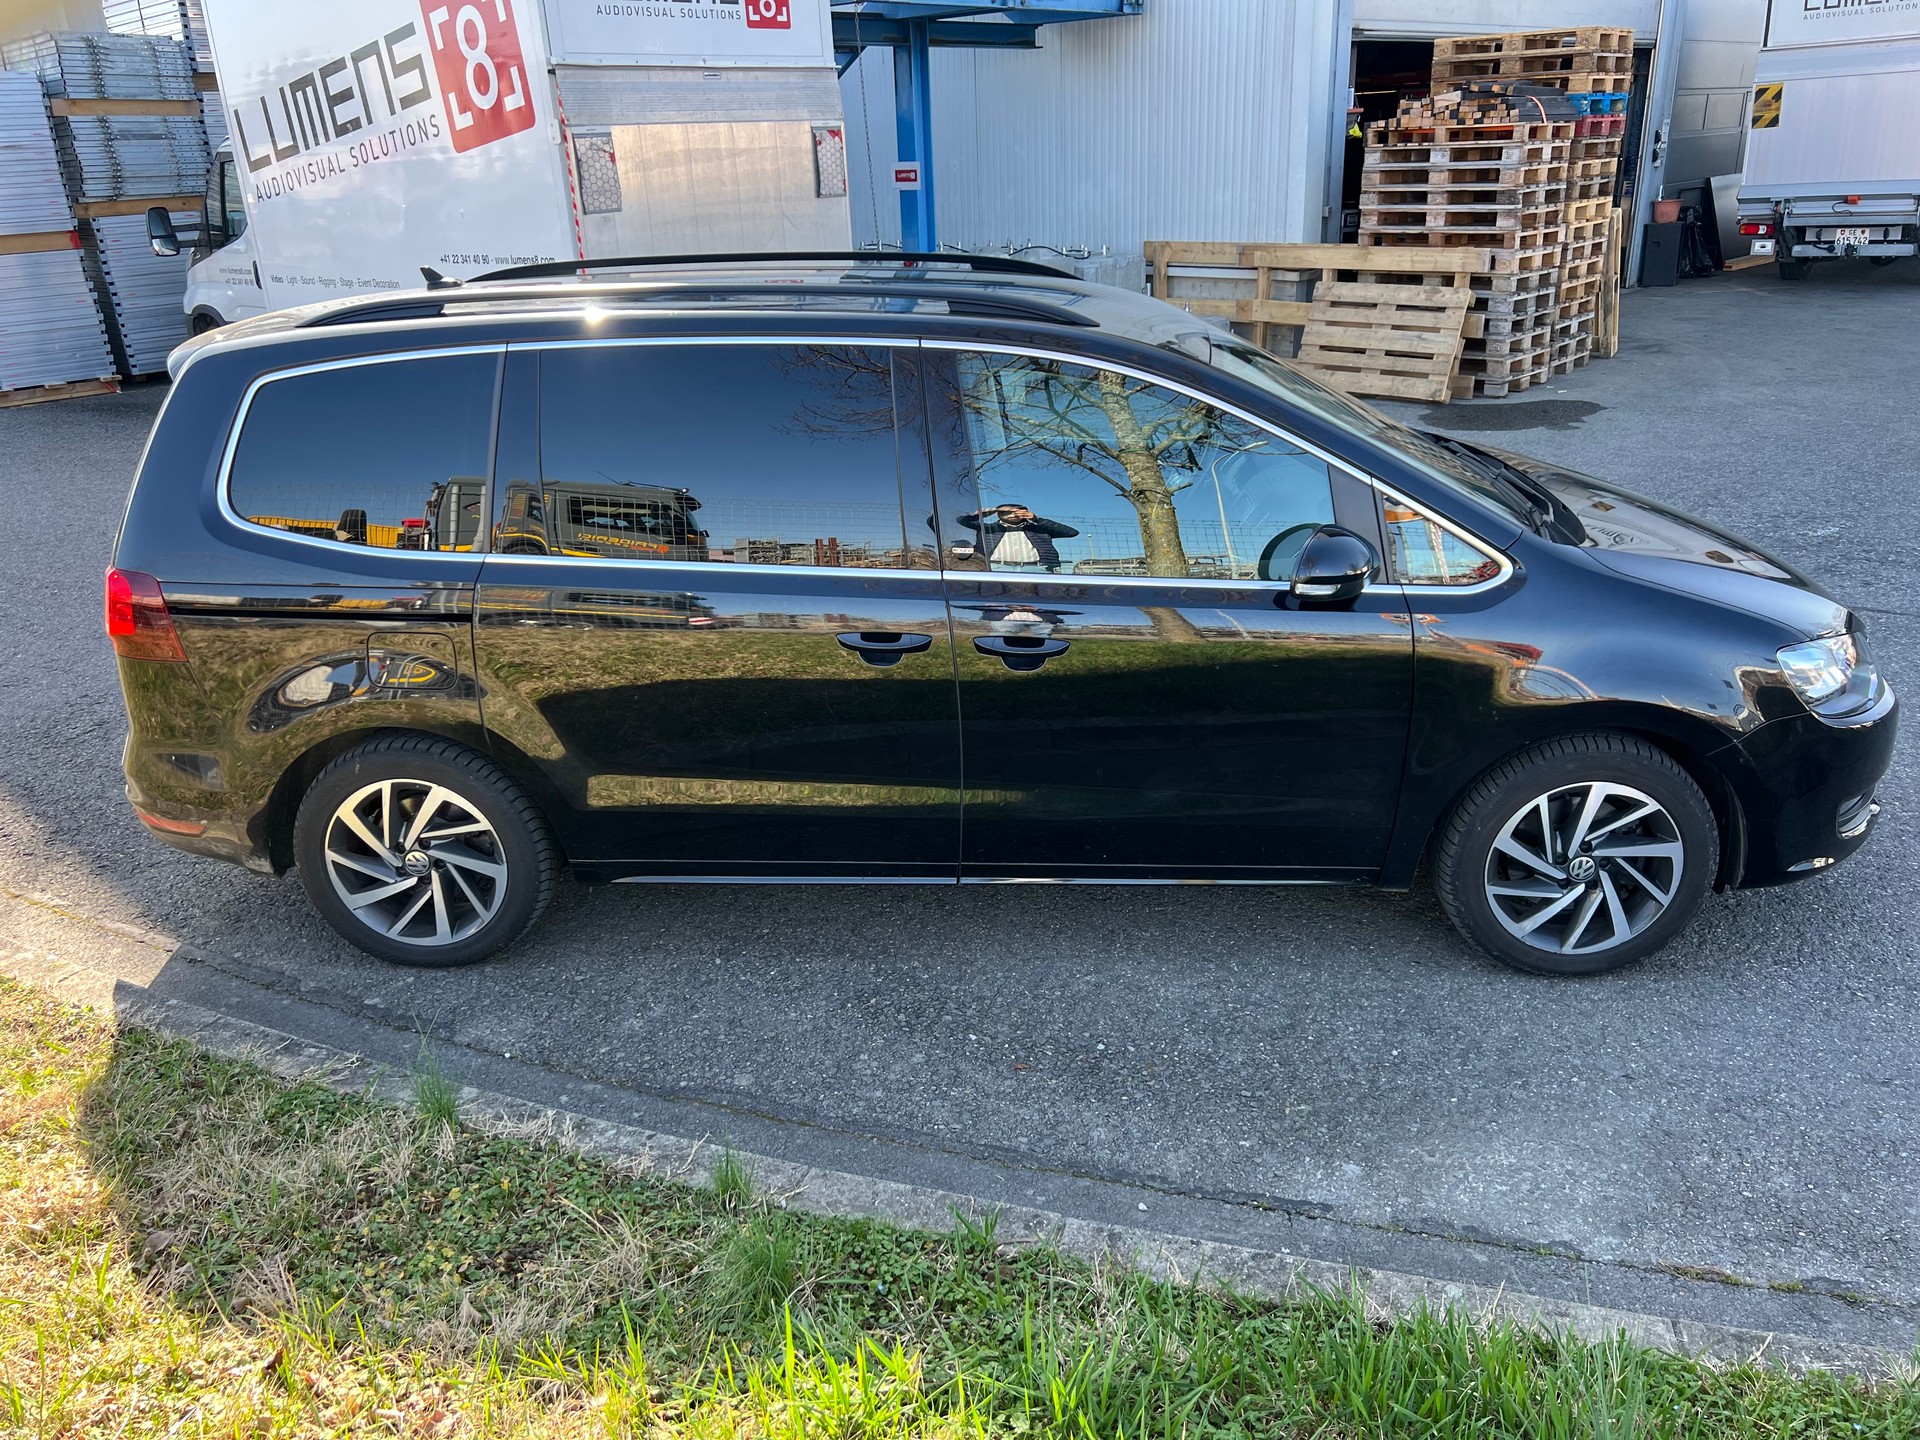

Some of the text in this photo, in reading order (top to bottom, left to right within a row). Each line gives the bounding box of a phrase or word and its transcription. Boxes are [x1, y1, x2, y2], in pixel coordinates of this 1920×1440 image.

[596, 4, 741, 20] AUDIOVISUAL SOLUTIONS
[1802, 8, 1865, 20] AUDIOVISUAL
[1869, 3, 1920, 14] SOLUTION
[233, 4, 499, 174] LUMENS 8
[254, 114, 441, 204] AUDIOVISUAL SOLUTIONS
[440, 254, 450, 264] +41
[452, 254, 460, 264] 22
[460, 254, 471, 264] 341
[472, 254, 480, 264] 40
[481, 254, 489, 265] 90
[494, 254, 556, 265] www.lumens8com
[269, 274, 284, 283] Video
[286, 275, 298, 286] Light
[300, 275, 316, 285] Sound
[318, 276, 337, 288] Rigging
[339, 276, 354, 289] Stage
[357, 277, 372, 287] Event
[372, 278, 400, 289] Decoration
